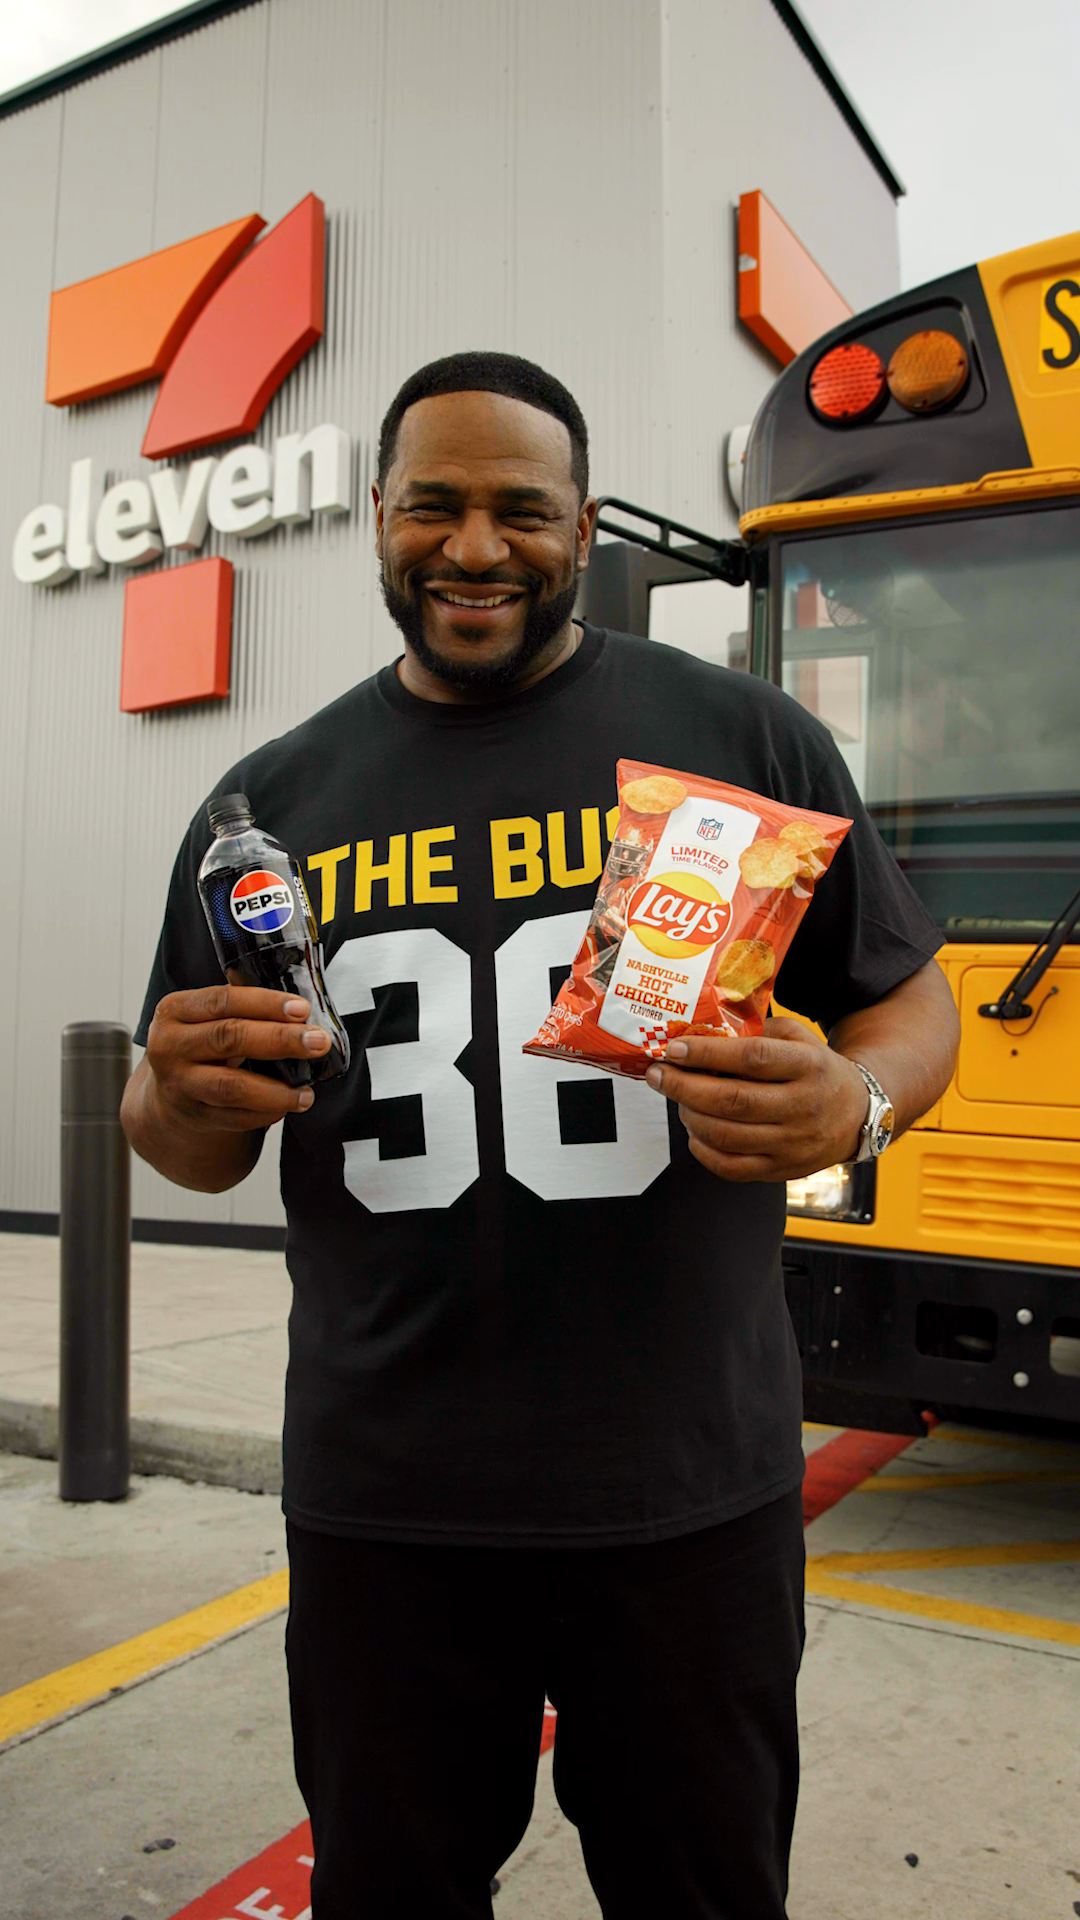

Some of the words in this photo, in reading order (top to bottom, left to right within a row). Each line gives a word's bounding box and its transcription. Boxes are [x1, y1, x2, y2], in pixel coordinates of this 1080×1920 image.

[12, 423, 350, 586] eleven
[699, 825, 718, 839] NFL
[671, 846, 729, 870] LIMITED
[671, 856, 692, 864] TIME
[693, 858, 723, 876] FLAVOR
[307, 825, 458, 924] THE
[234, 890, 291, 916] PEPSI
[631, 883, 727, 940] Lay's
[626, 958, 689, 984] NASHVILLE
[637, 974, 673, 995] HOT
[613, 983, 688, 1016] CHICKEN
[629, 1003, 663, 1021] FLAVORED
